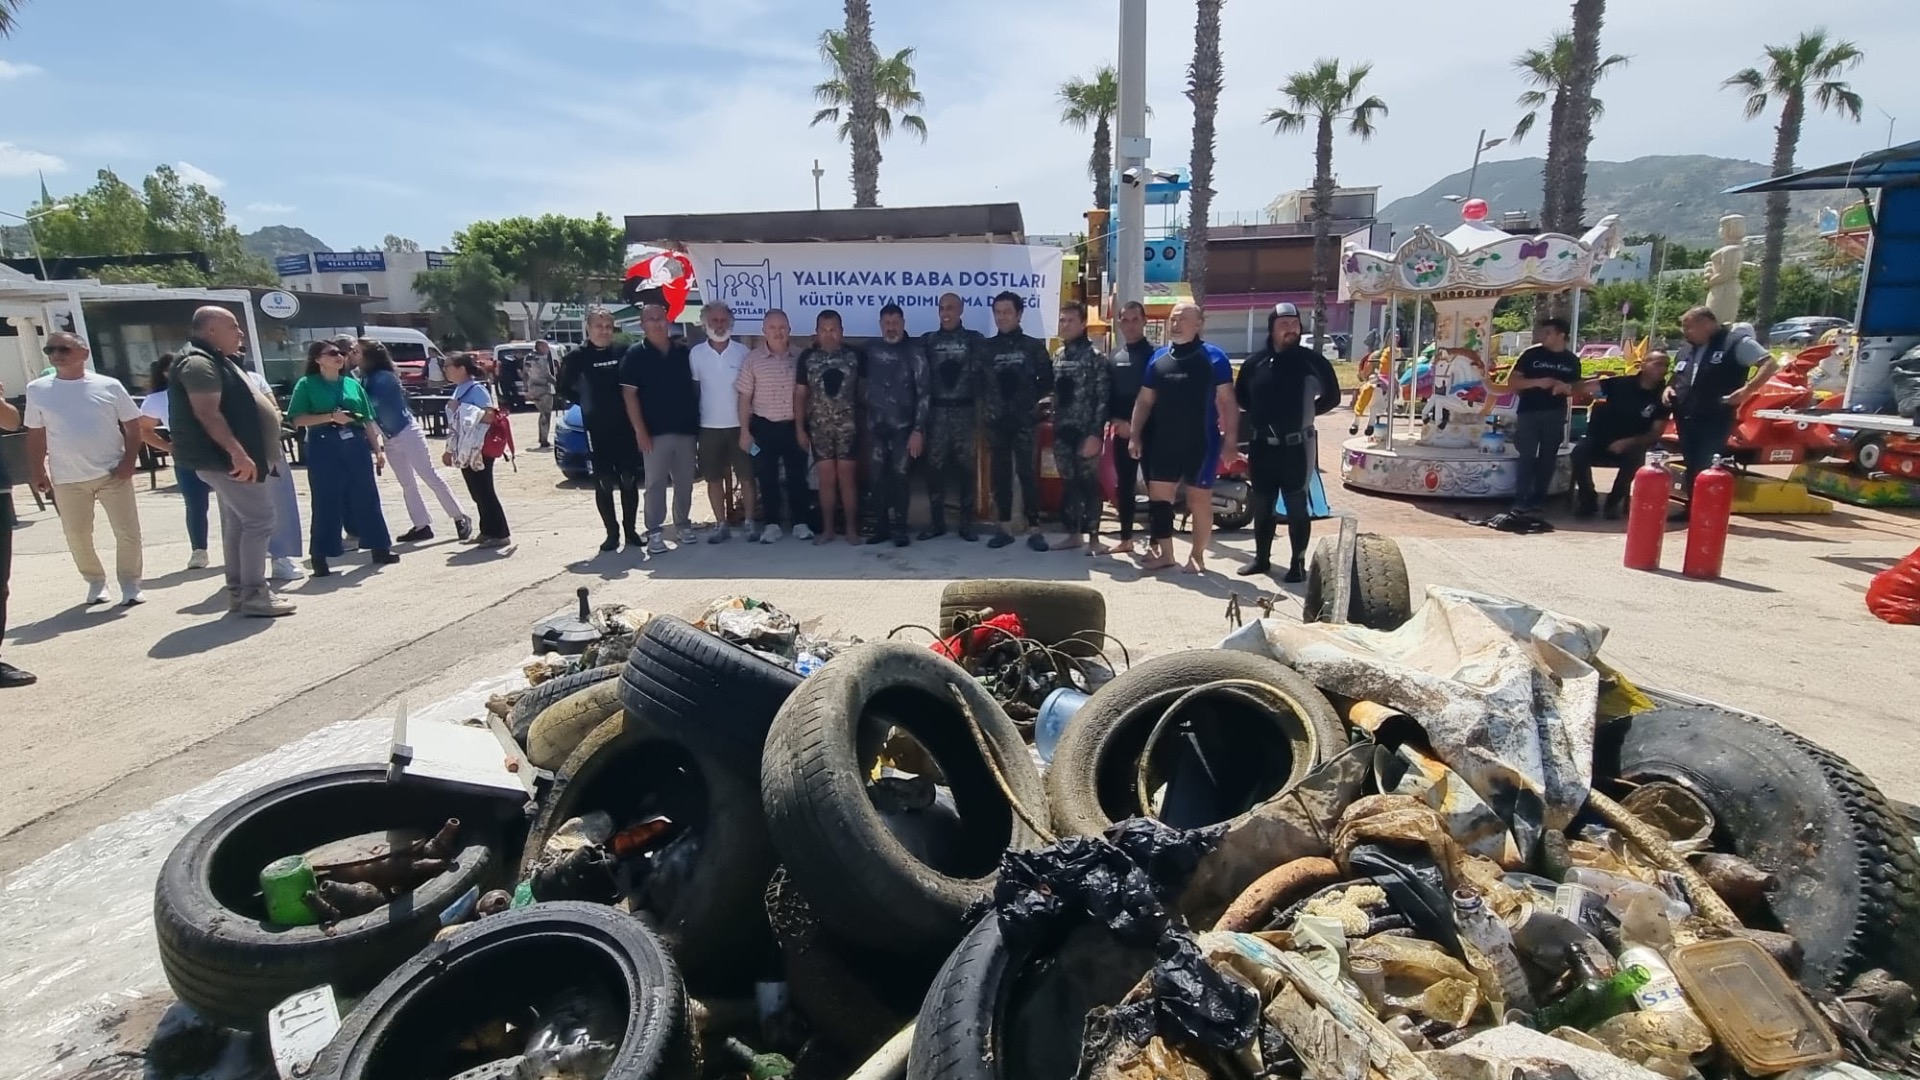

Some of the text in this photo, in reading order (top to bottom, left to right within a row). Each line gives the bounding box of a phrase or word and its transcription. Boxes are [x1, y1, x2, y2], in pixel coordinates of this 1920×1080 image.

[793, 271, 1046, 289] YALIKAVAK BABA DOSTLARI
[799, 291, 1041, 308] KÜLTÜR VE YARDIMLMA DEĞİ
[731, 307, 767, 315] OSTLARI
